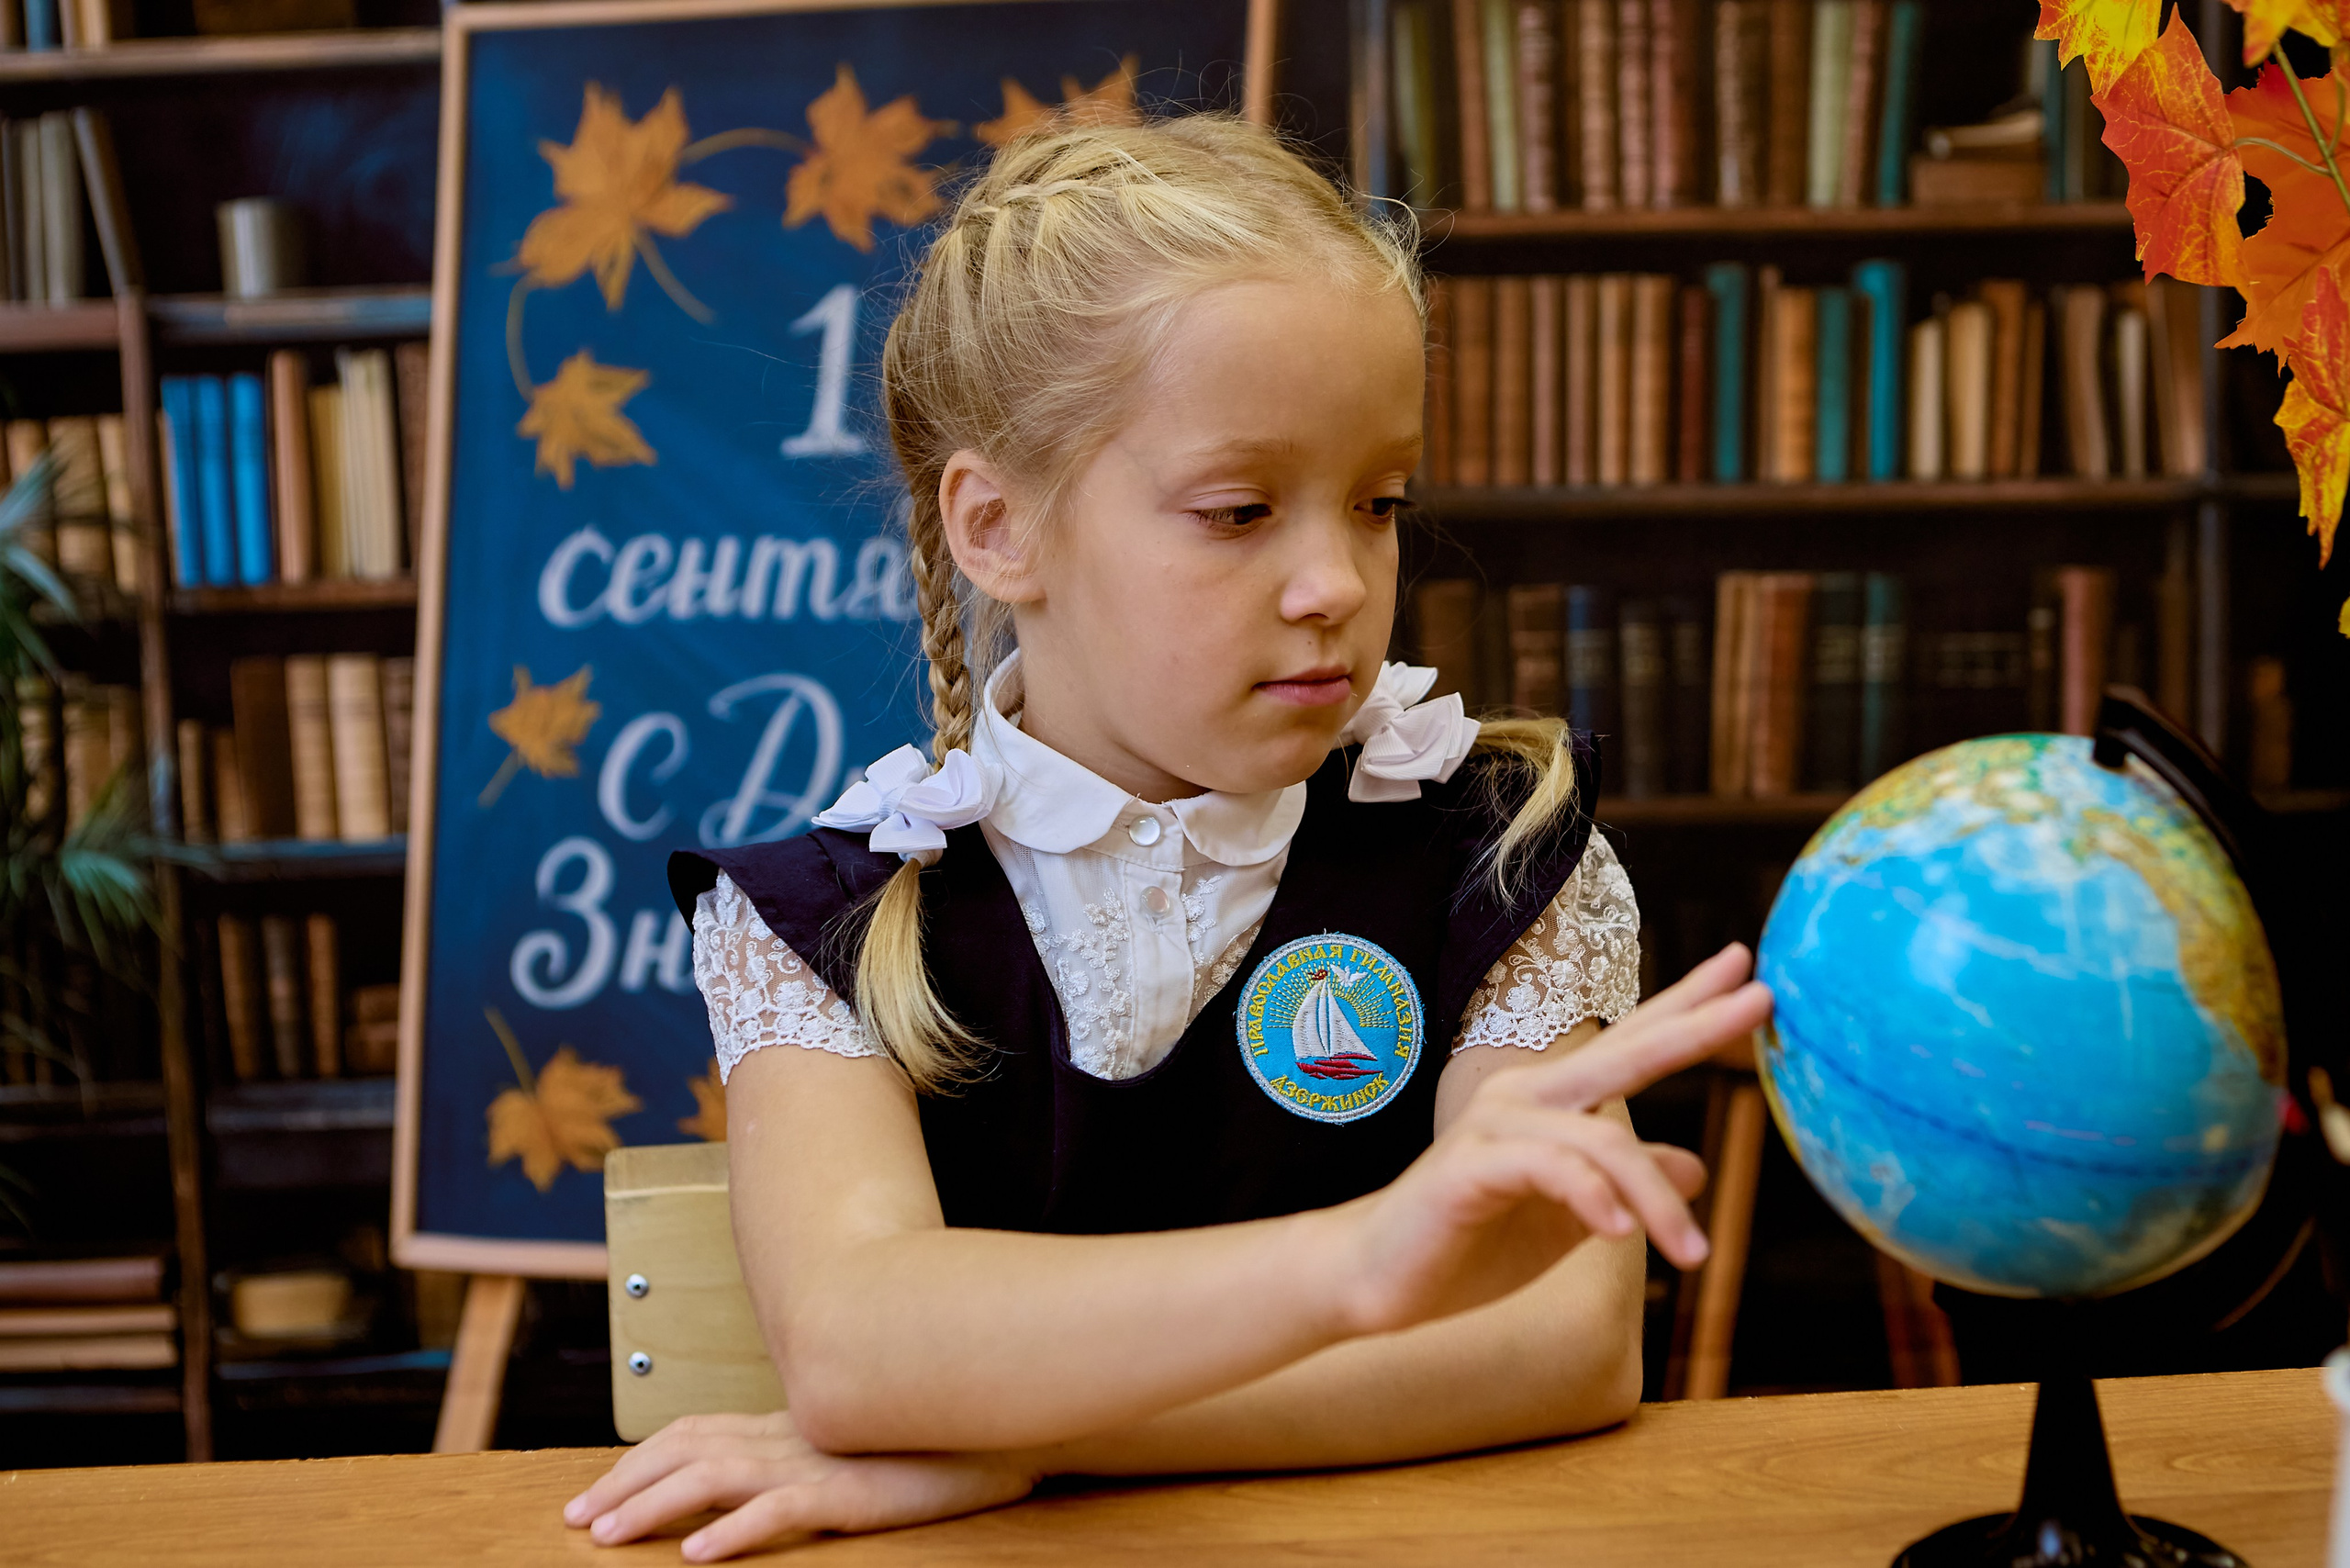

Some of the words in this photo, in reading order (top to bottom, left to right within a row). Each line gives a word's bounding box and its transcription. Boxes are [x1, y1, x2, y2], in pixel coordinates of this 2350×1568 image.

[781, 284, 863, 458] 1
[538, 524, 918, 628] сентя
[699, 671, 867, 848] Д
[510, 836, 695, 1008] Зн
[1248, 946, 1343, 1057] ПРАВОСЛАВНАЯ
[1349, 949, 1413, 1059] ГИМНАЗИЯ
[1270, 1072, 1389, 1112] ДЗЕРЖИНСК
